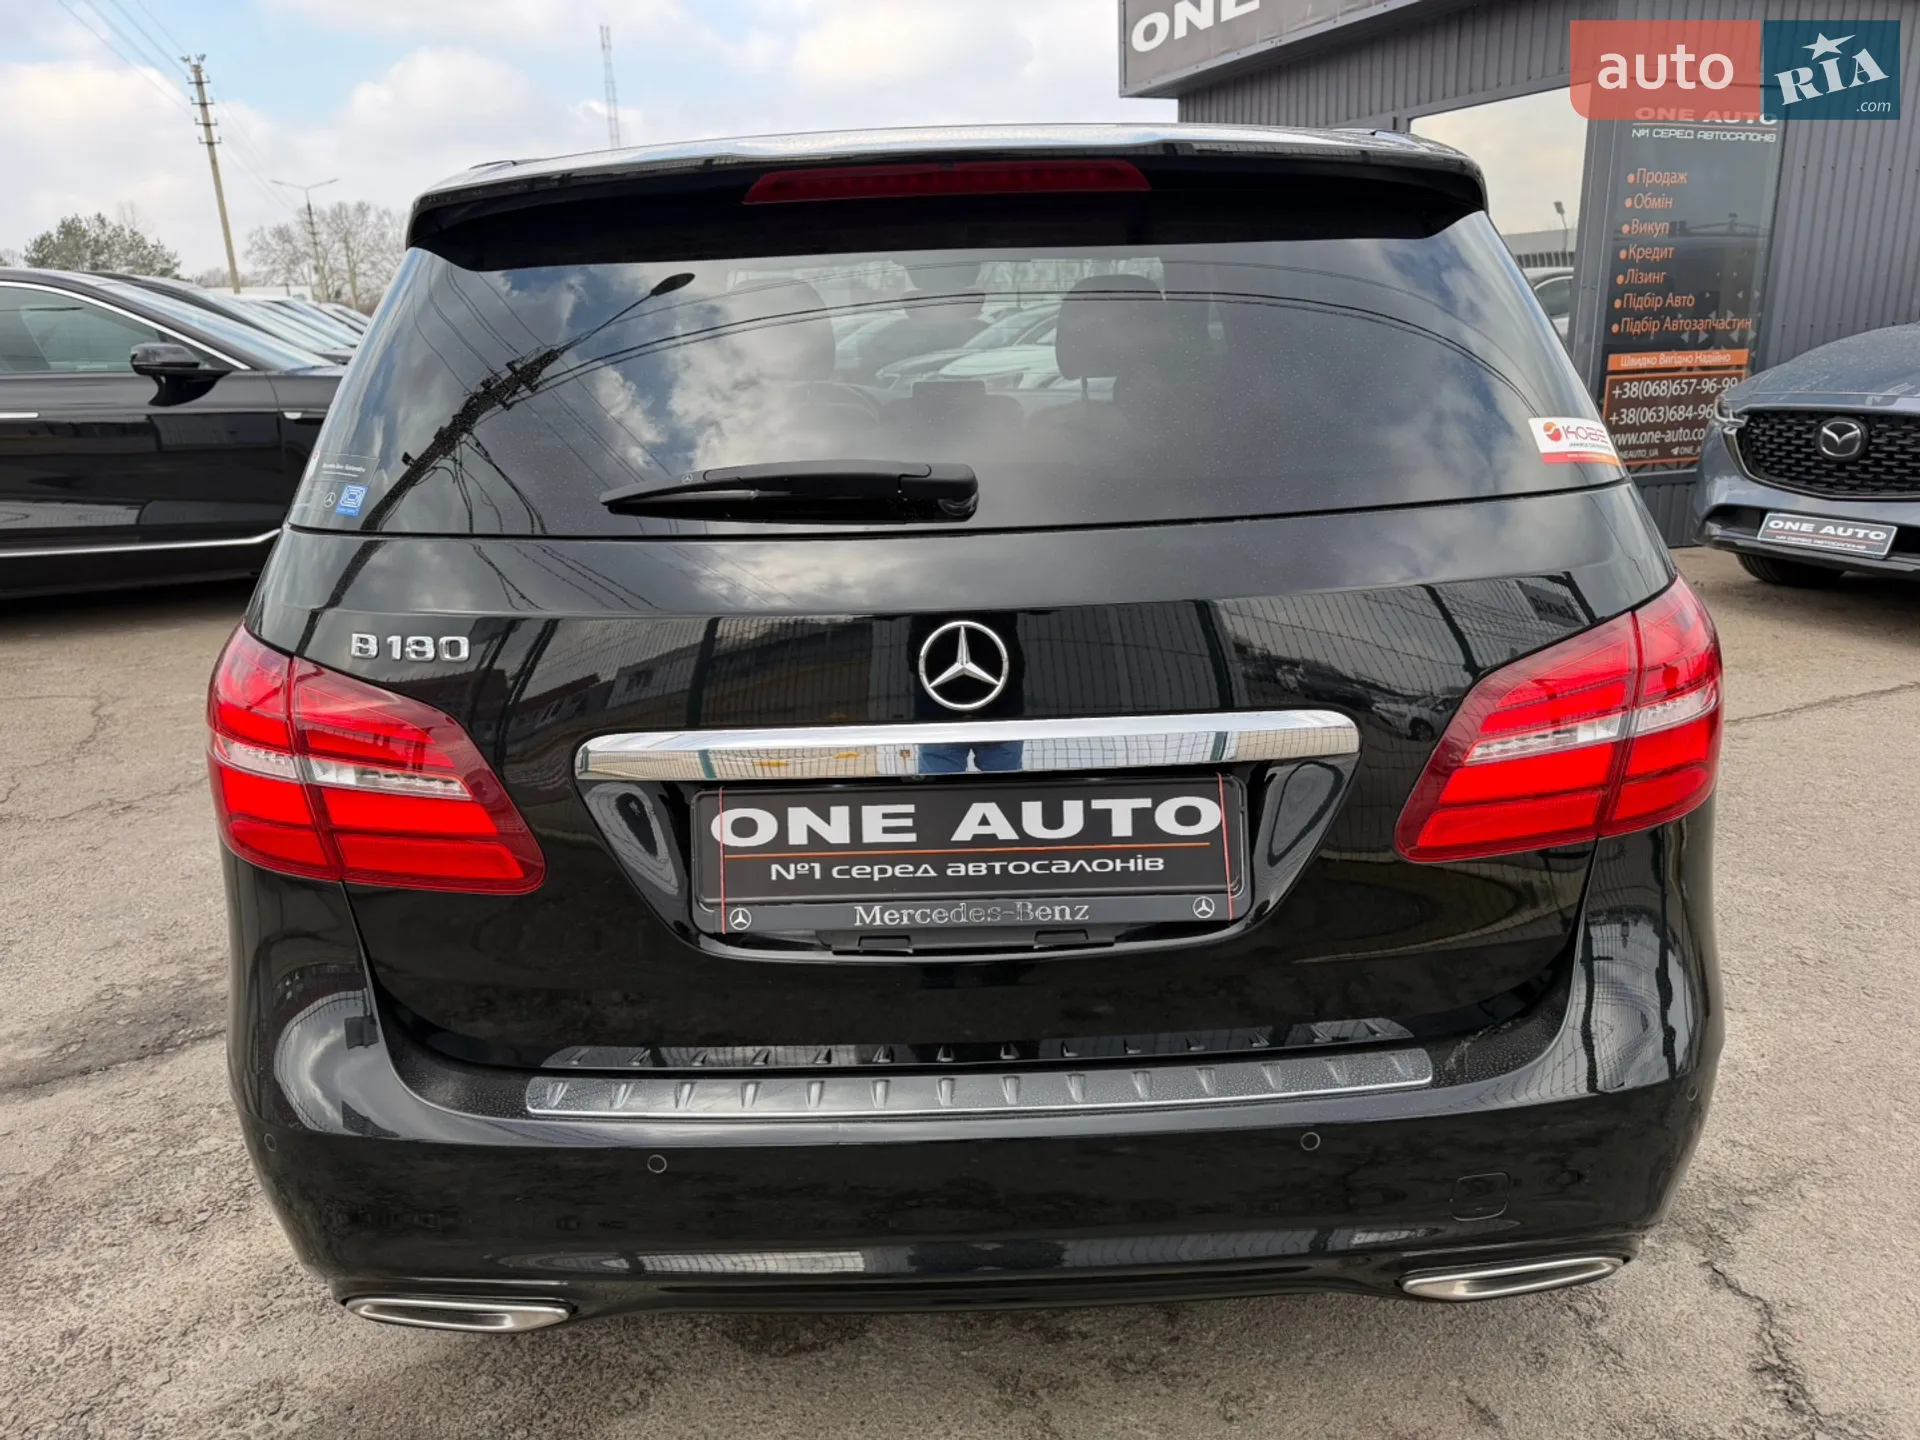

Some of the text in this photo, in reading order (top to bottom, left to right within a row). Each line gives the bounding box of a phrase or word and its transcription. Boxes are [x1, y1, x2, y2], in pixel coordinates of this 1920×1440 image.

[1635, 107, 1778, 125] ONE AUTO
[1636, 168, 1687, 187] Продаж
[1633, 193, 1673, 209] Обмін
[1631, 219, 1669, 238] Викуп
[1628, 244, 1674, 263] Кредит
[1625, 268, 1666, 285] Лізинг
[1623, 292, 1695, 311] Підбір Авто
[1620, 316, 1659, 335] Підбір
[1768, 519, 1887, 540] ONE AUTO
[350, 633, 471, 662] B 180
[711, 796, 1222, 847] ONE AUTO
[770, 855, 1165, 882] №1 серед автосалонів
[854, 901, 1090, 926] Mercedes-Benz
